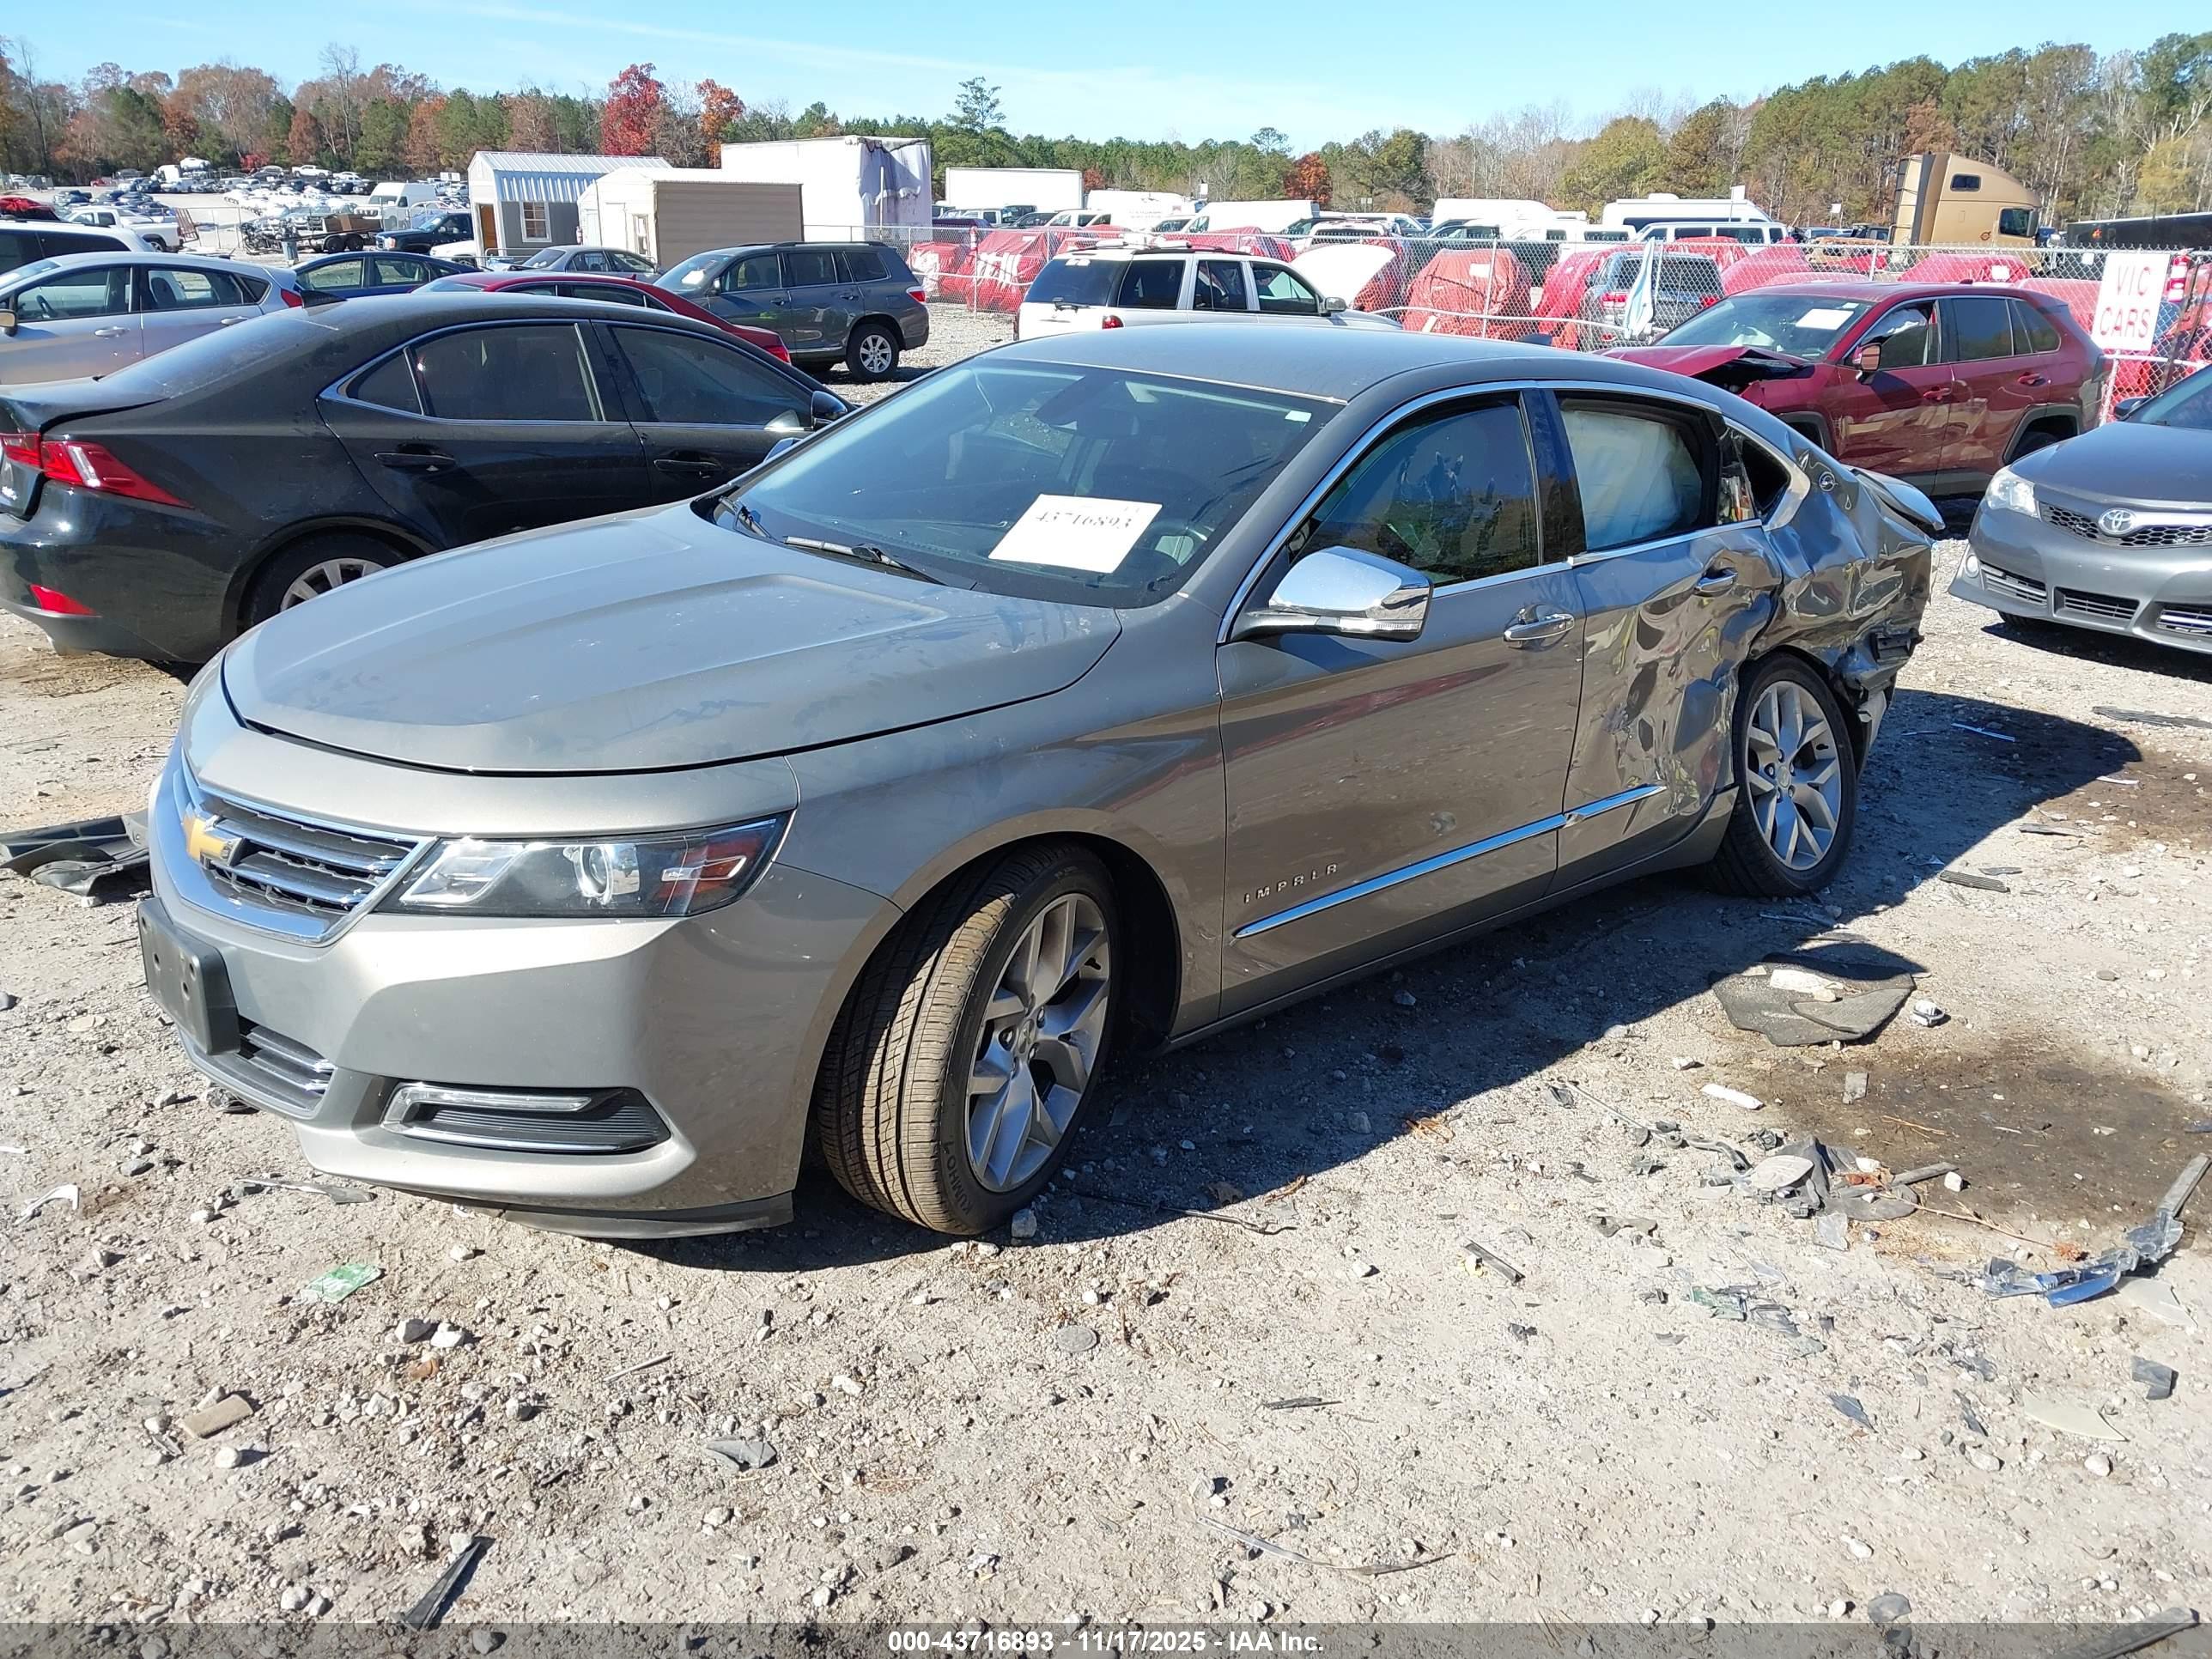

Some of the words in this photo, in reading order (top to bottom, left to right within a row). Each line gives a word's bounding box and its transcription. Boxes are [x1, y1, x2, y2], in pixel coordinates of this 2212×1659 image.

[2116, 264, 2152, 297] VIC
[2099, 306, 2152, 339] CARS
[1243, 862, 1338, 904] IMPALA
[945, 1153, 975, 1216] KUMHO
